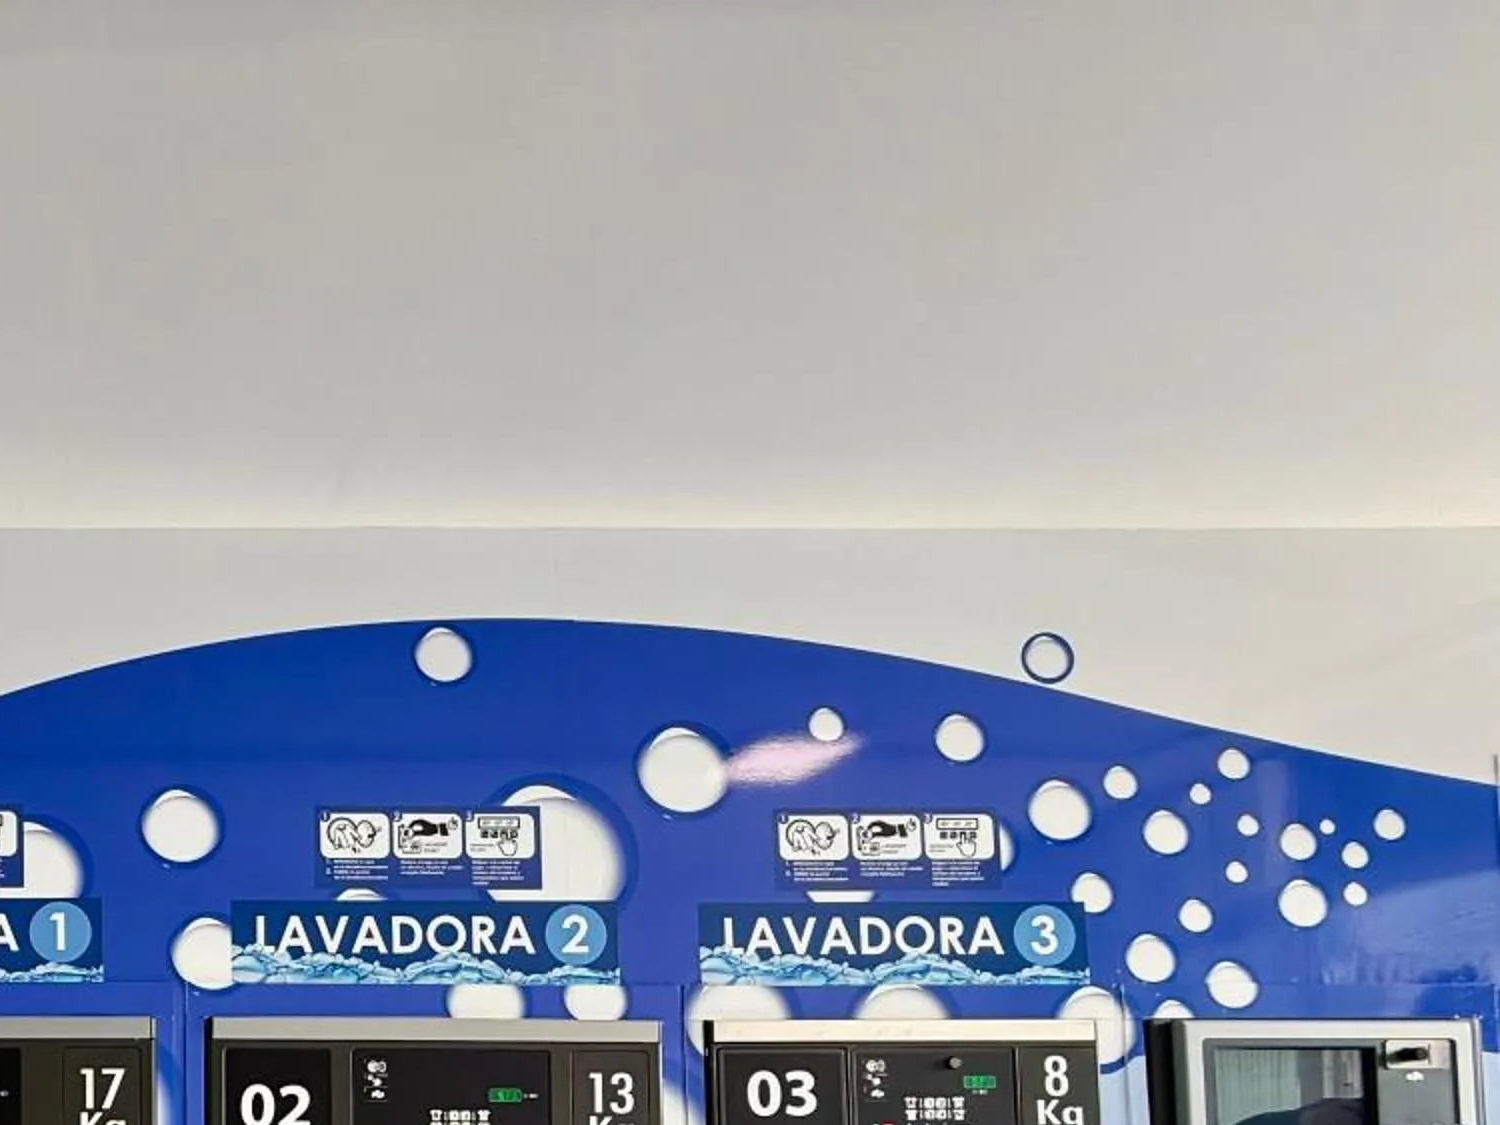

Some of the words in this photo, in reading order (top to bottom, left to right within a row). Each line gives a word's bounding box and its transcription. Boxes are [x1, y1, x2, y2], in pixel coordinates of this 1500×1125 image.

[48, 913, 65, 950] 1
[255, 916, 534, 954] LAVADORA
[563, 916, 589, 953] 2
[723, 917, 1003, 955] LAVADORA
[1031, 916, 1057, 953] 3
[80, 1068, 124, 1109] 17
[590, 1073, 635, 1114] 13
[747, 1071, 817, 1117] 03
[1044, 1055, 1068, 1096] 8
